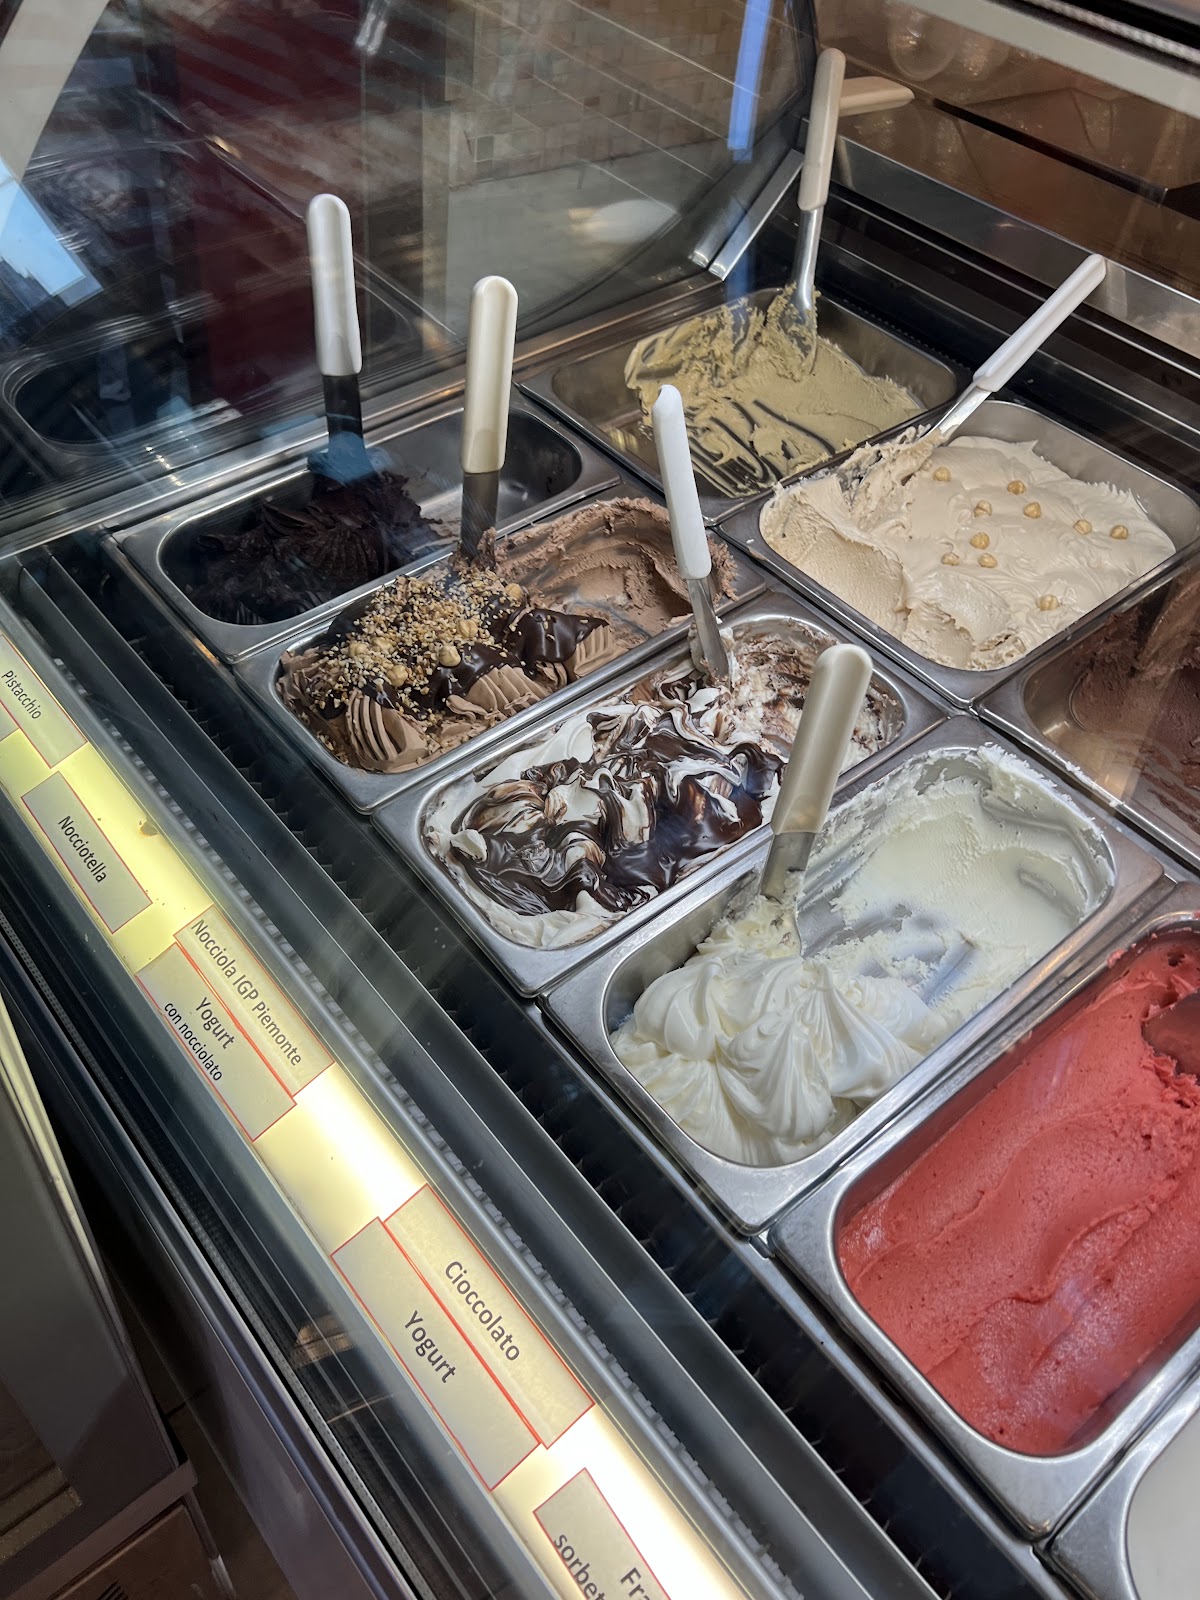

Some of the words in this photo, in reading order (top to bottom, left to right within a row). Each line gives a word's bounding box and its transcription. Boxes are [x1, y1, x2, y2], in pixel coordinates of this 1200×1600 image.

[2, 670, 42, 720] Pistacchio
[58, 815, 107, 884] Nocciotella
[190, 919, 237, 979] Nocciola
[231, 975, 260, 1002] IGP
[252, 1001, 302, 1066] Piemonte
[195, 997, 236, 1050] Yogurt
[163, 1002, 183, 1025] con
[178, 1023, 223, 1081] nocciolato
[404, 1309, 456, 1384] Yogurt
[445, 1261, 520, 1361] Cioccolato
